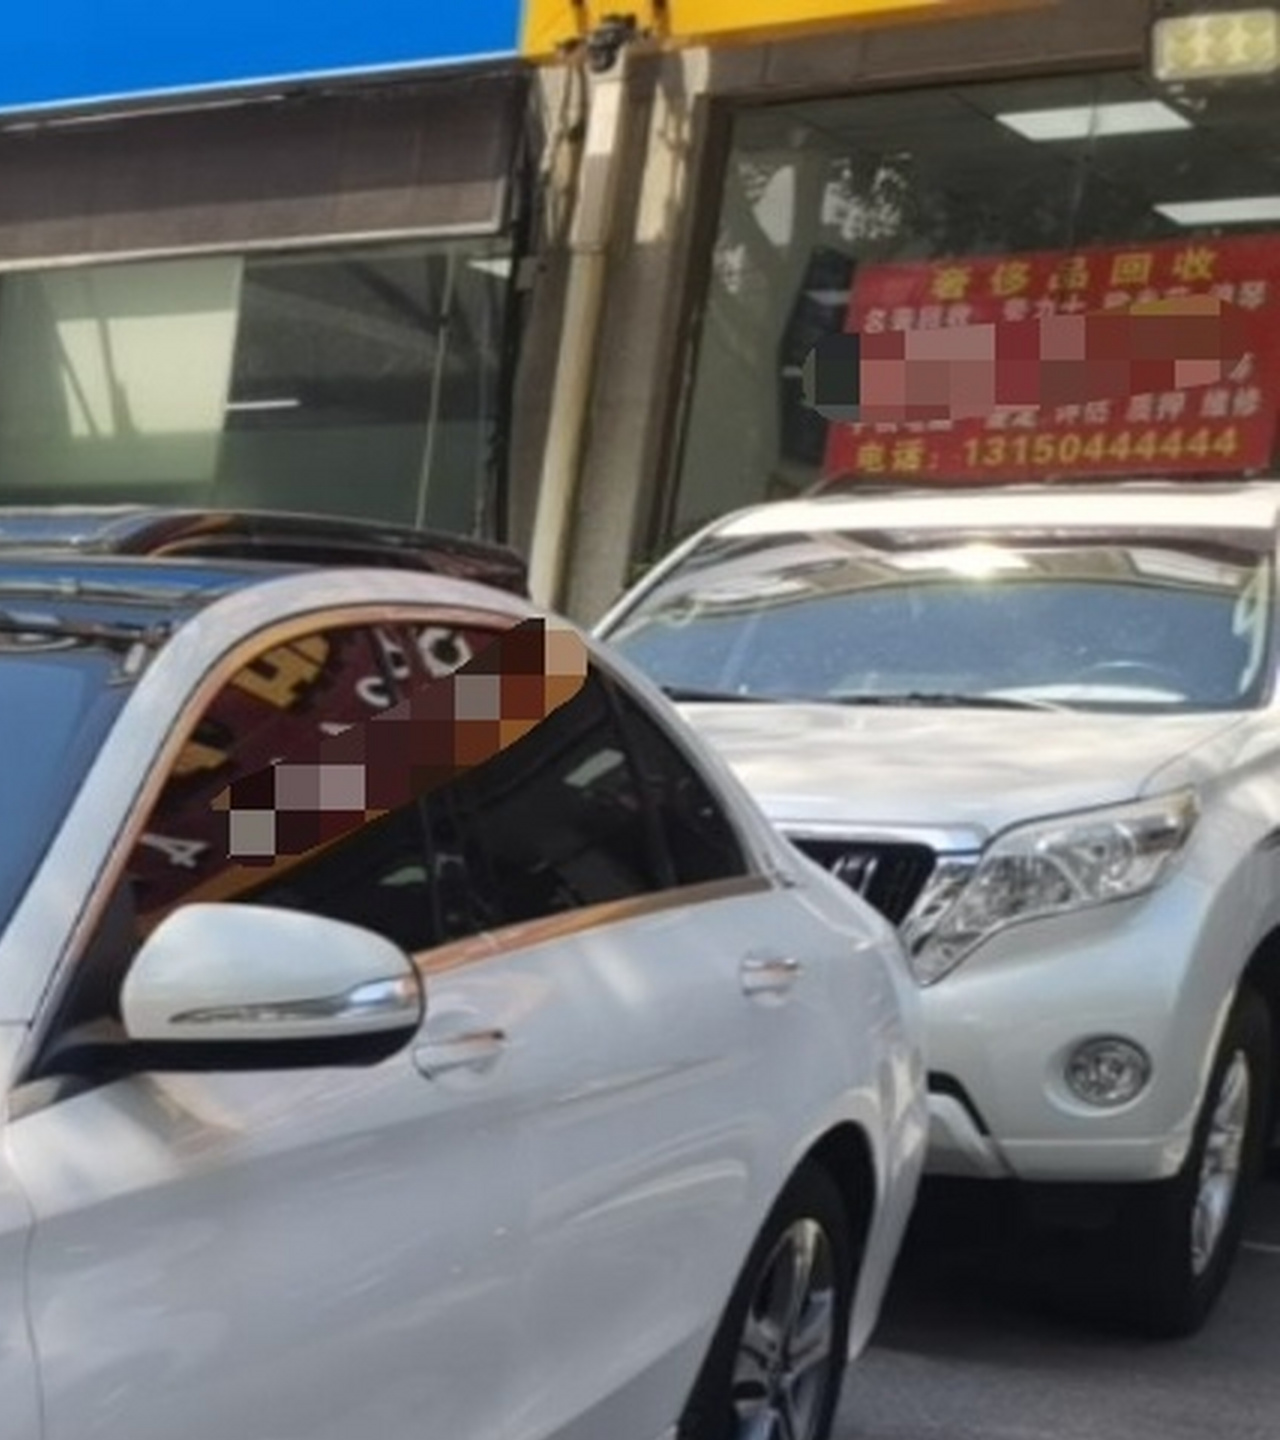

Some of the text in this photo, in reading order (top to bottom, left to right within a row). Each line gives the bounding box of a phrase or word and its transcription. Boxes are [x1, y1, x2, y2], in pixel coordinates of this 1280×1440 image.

[930, 246, 1218, 301] 奢侈品回收
